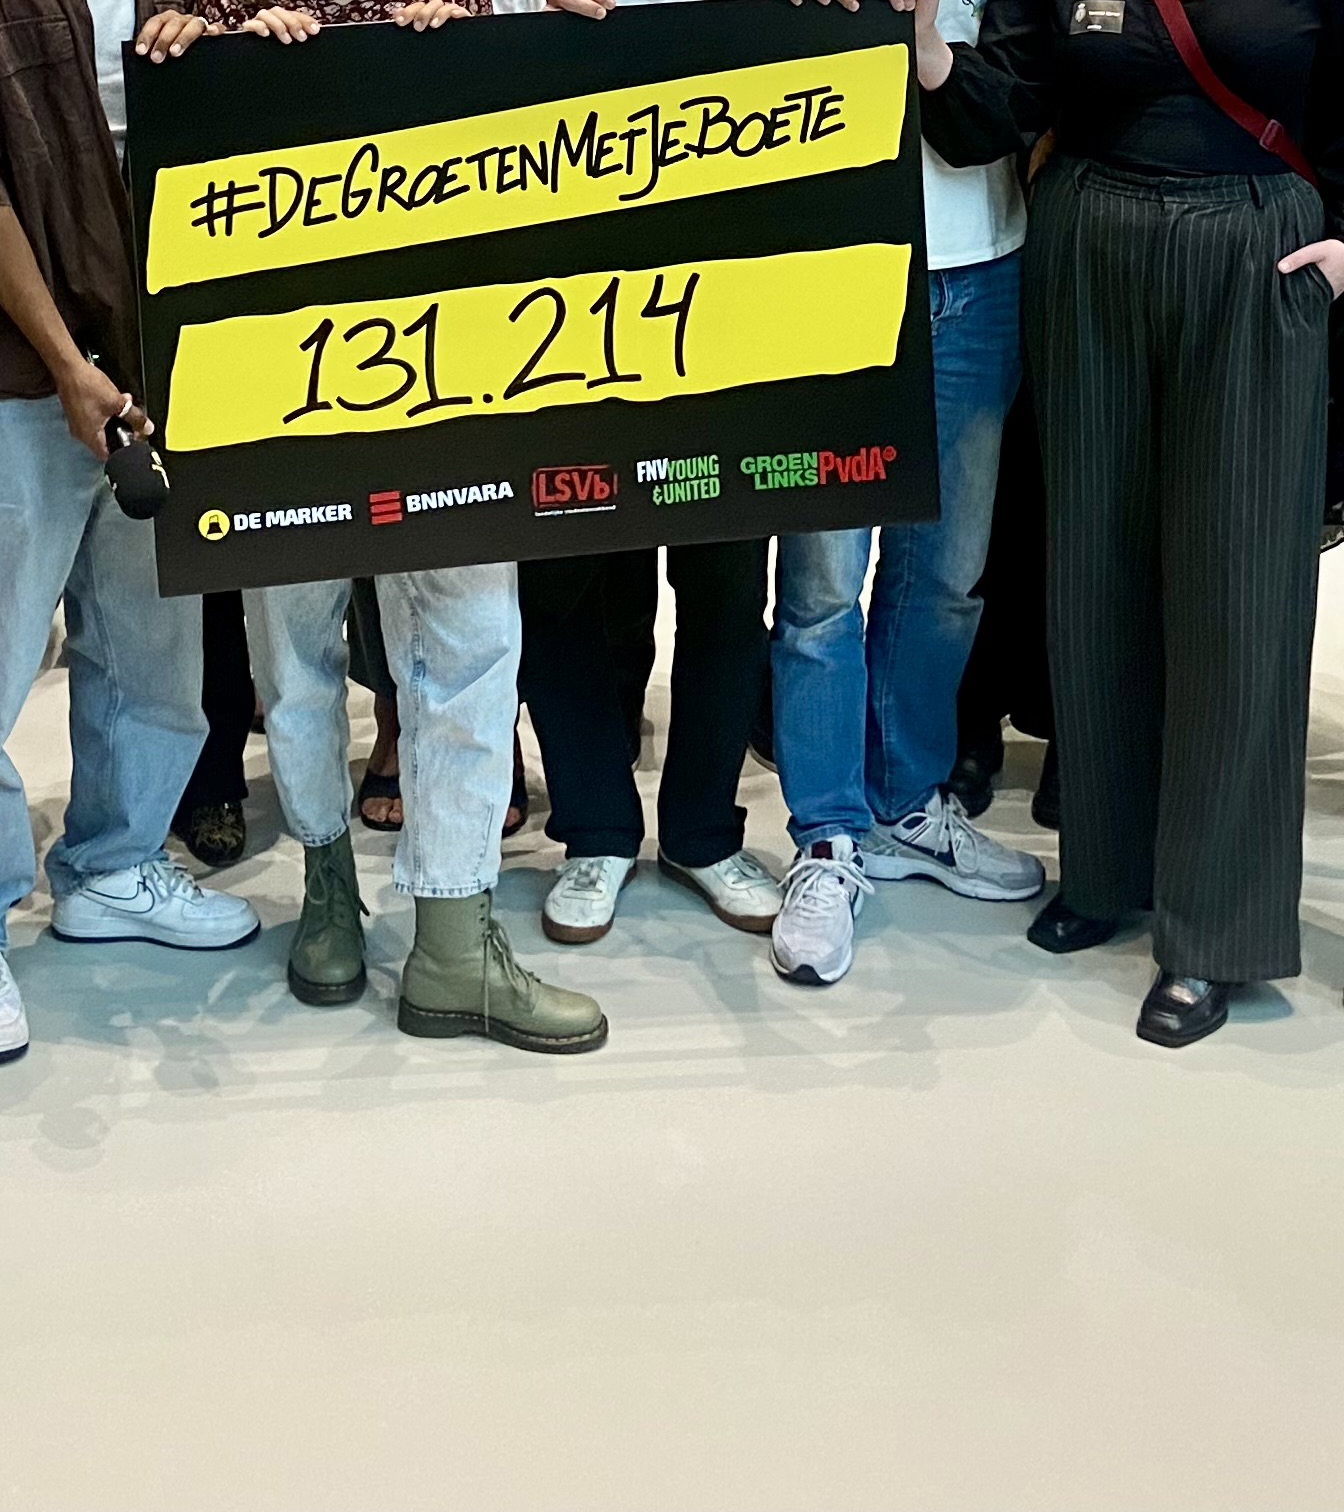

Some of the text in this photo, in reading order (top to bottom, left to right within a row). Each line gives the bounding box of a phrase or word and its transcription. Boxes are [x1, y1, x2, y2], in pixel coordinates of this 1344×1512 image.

[283, 273, 700, 424] 131.214
[740, 452, 818, 474] GROEN
[539, 471, 610, 503] LSVb
[754, 469, 819, 490] LINKS
[406, 481, 514, 513] BNNVARA
[233, 503, 352, 531] DE MARKER
